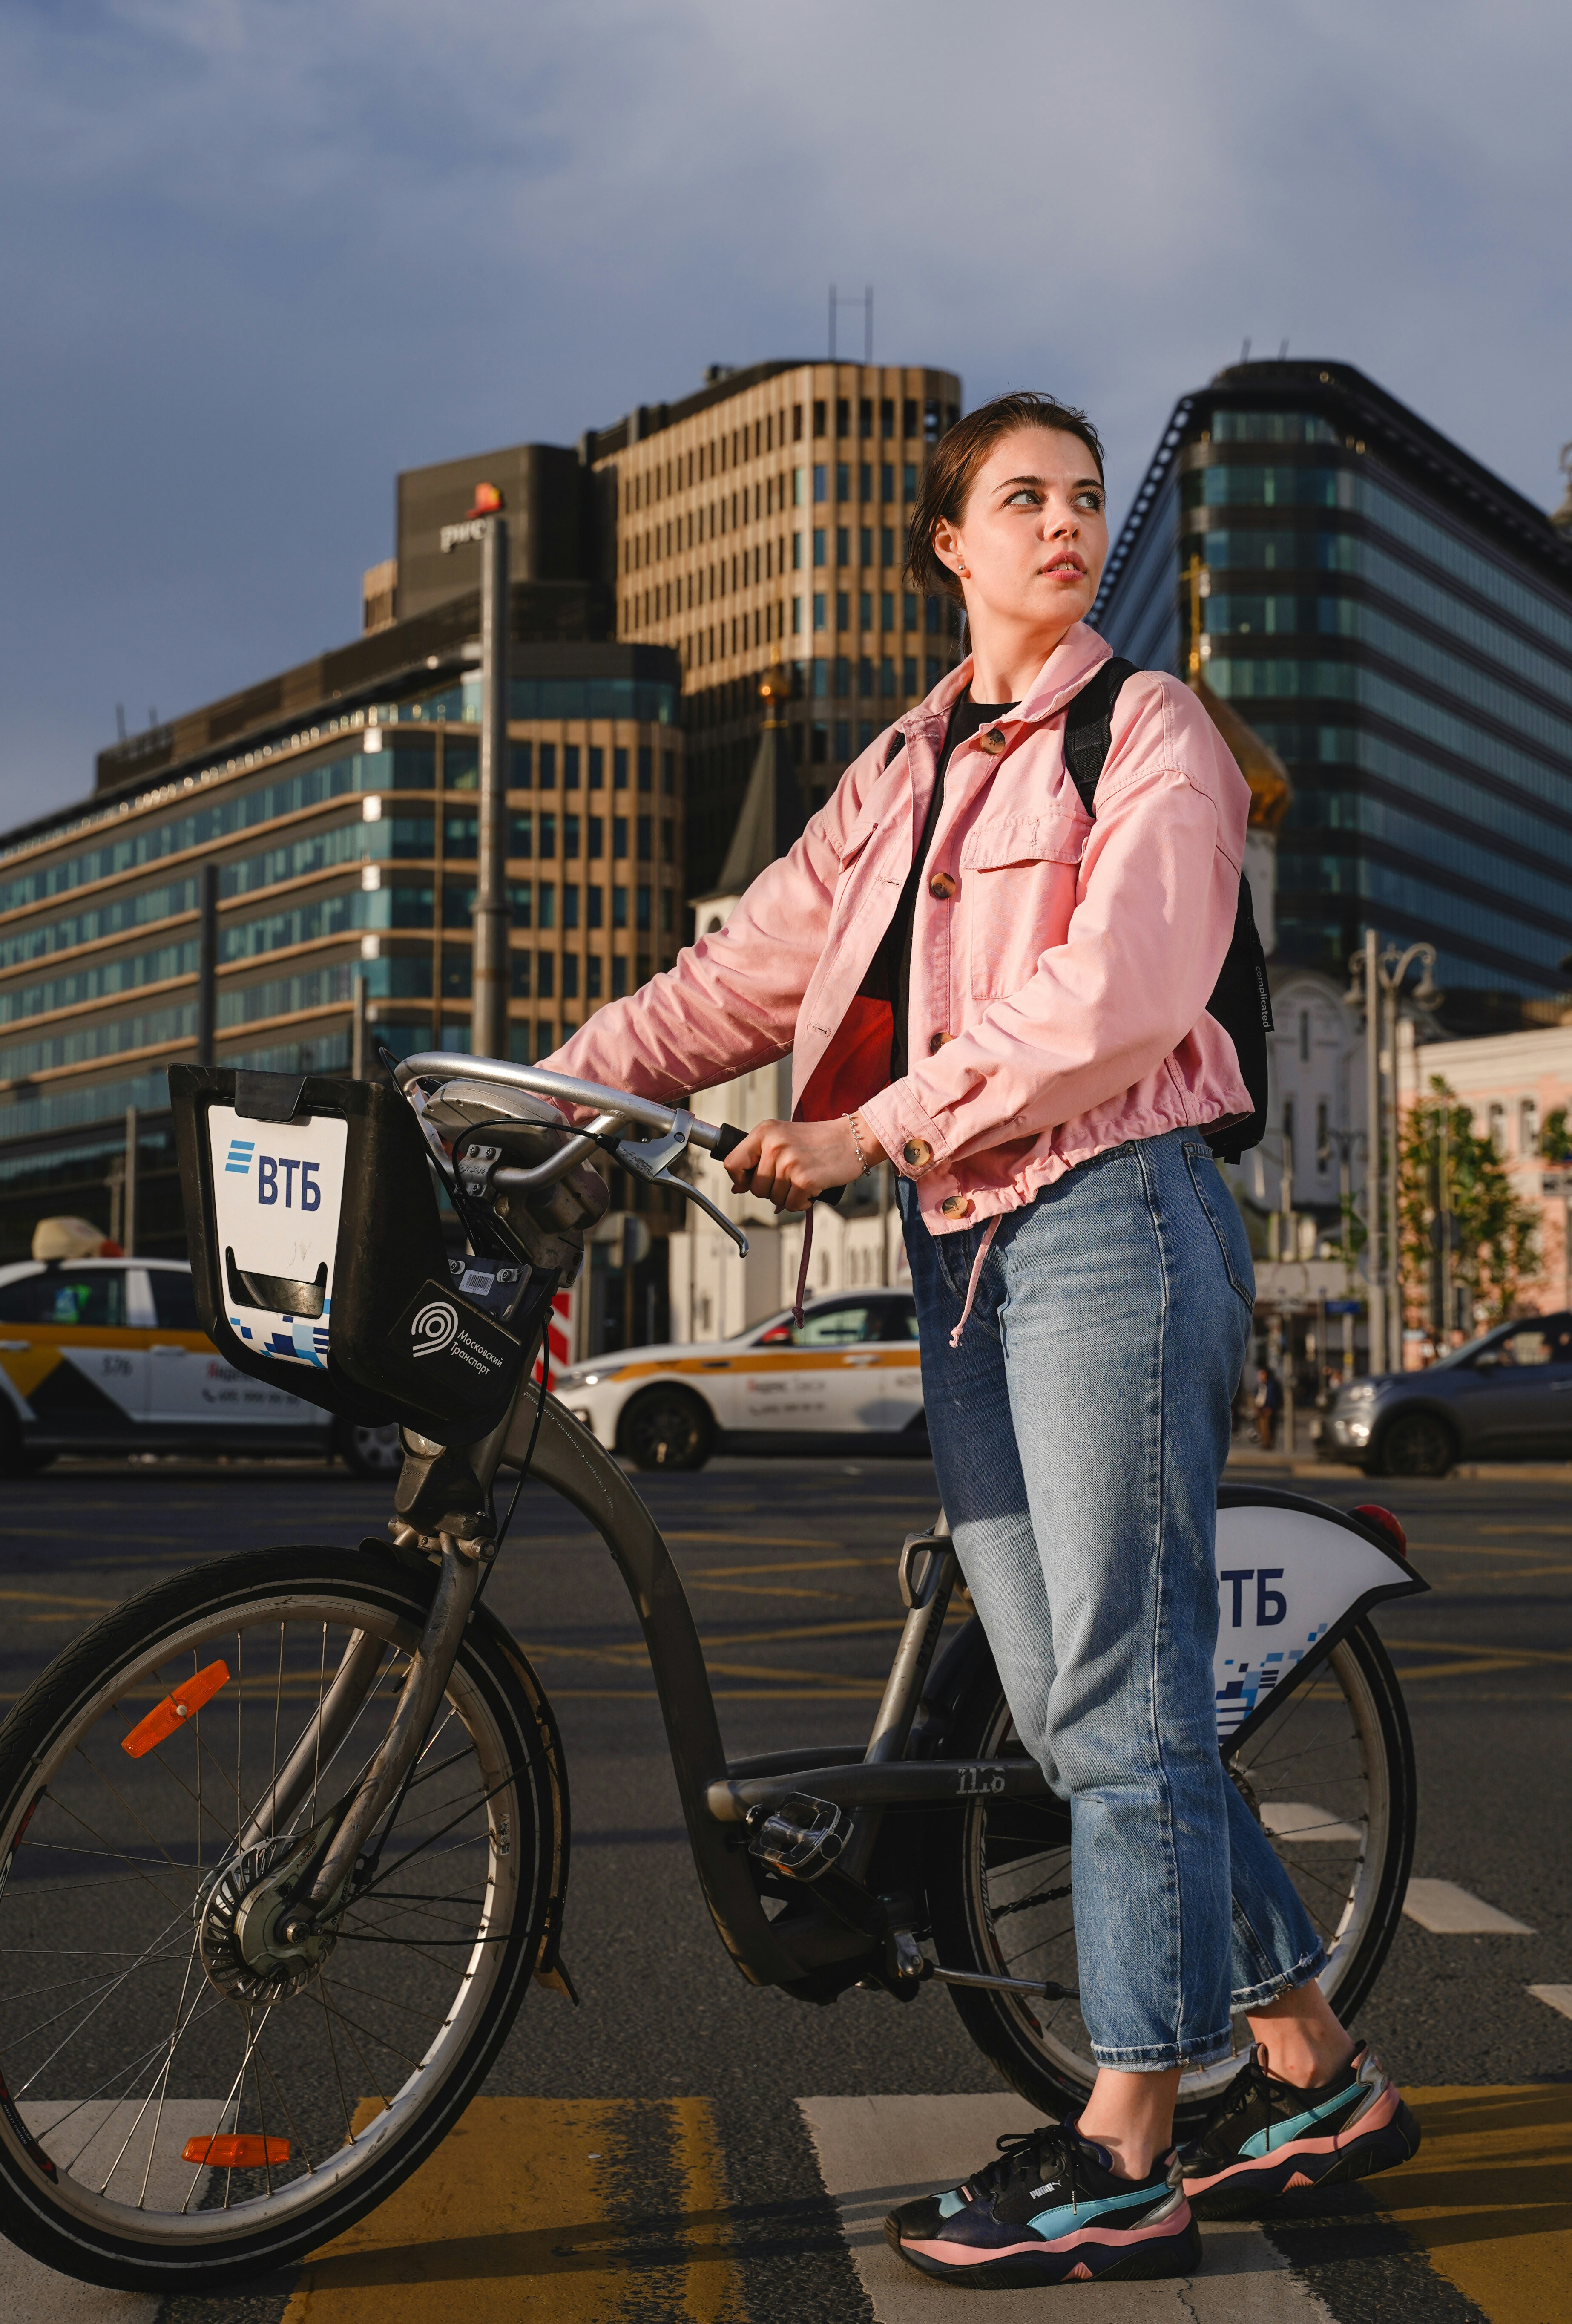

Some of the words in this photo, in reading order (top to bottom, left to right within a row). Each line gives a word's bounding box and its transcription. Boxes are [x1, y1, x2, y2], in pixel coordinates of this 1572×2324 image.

[1256, 966, 1271, 1028] complicated
[259, 1155, 321, 1211] ВТБ
[450, 1341, 490, 1375] Транспорт
[457, 1330, 504, 1368] Московский
[1216, 1568, 1287, 1627] ТБ
[1029, 2183, 1055, 2200] PUMA
